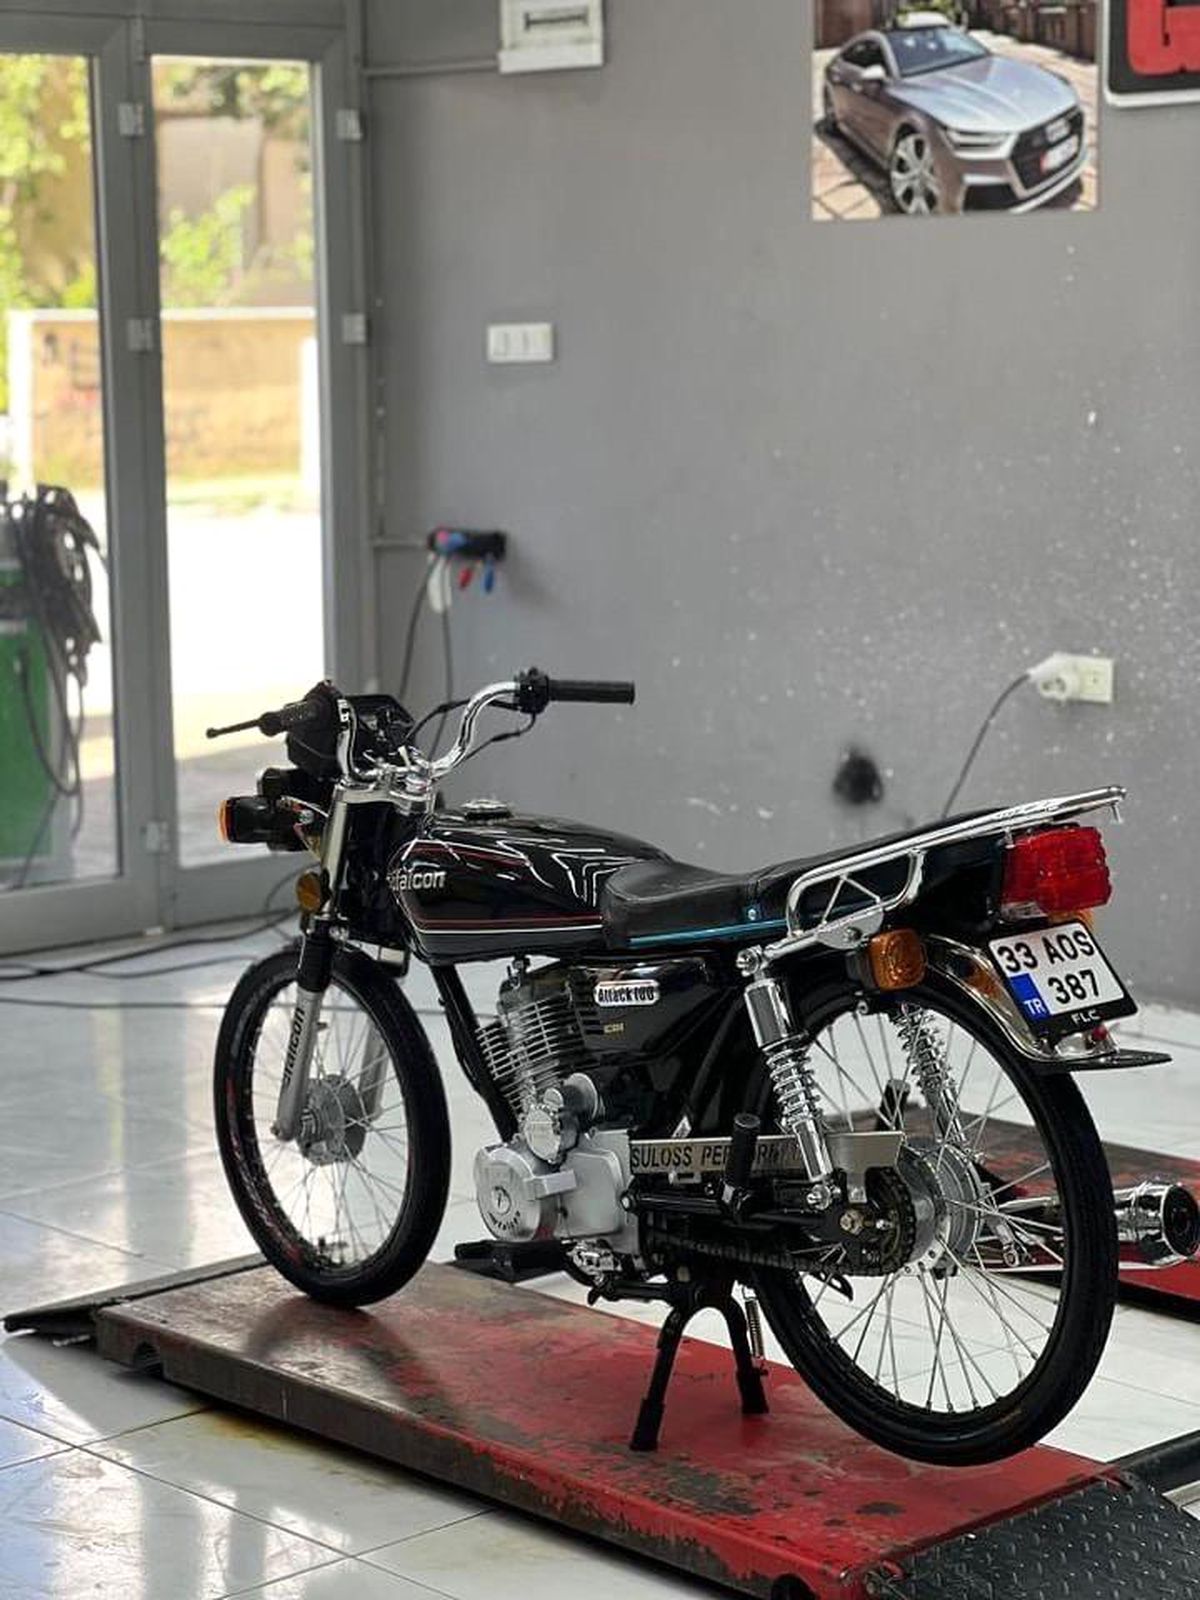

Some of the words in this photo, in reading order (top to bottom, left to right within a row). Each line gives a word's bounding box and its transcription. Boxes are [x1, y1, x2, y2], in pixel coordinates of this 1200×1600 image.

[997, 942, 1039, 973] 33
[1041, 930, 1095, 965] AOS
[1048, 969, 1099, 1005] 387
[1024, 1000, 1046, 1016] TR
[1071, 1010, 1101, 1026] FLC
